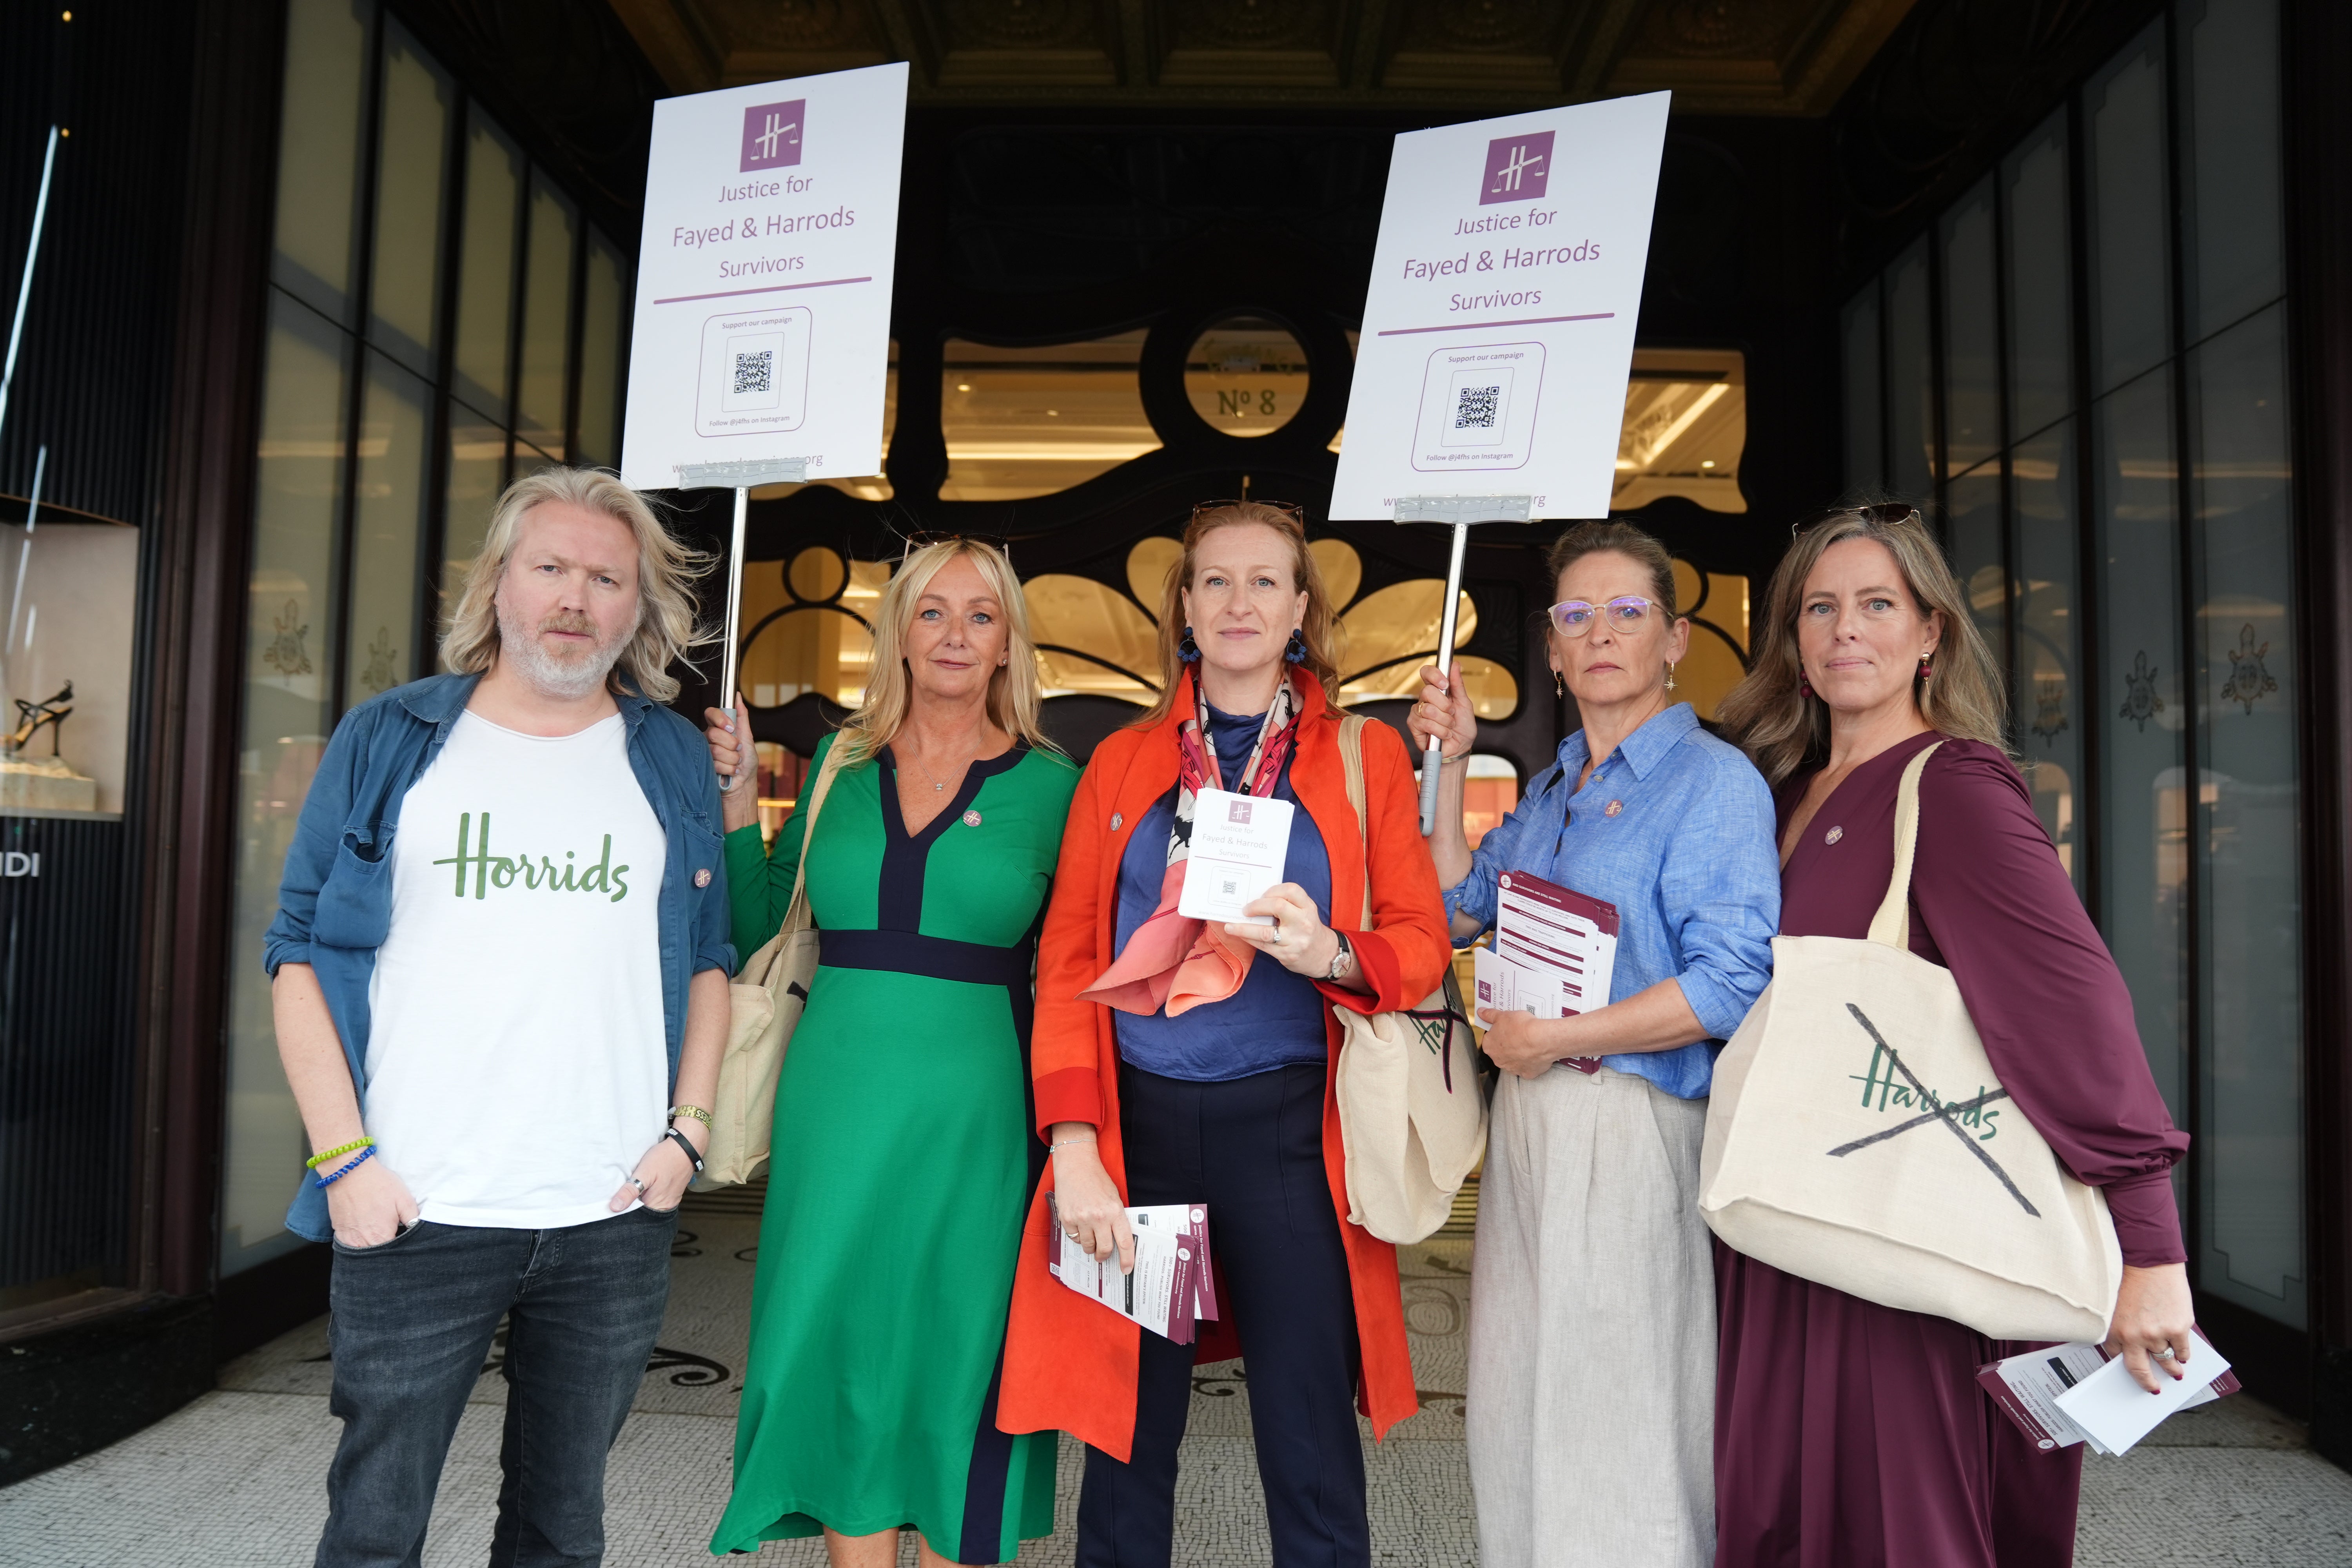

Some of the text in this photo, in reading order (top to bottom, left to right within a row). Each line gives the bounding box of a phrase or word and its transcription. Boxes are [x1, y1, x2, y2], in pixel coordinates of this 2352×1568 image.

[719, 176, 813, 202] Justice for
[673, 206, 854, 249] Fayed & Harrods
[1454, 208, 1557, 235] Justice for
[719, 256, 804, 278] Survivors
[1404, 240, 1600, 281] Fayed & Harrods
[1450, 290, 1541, 311] Survivors
[761, 317, 792, 325] campaign
[1260, 390, 1276, 415] 8
[1220, 824, 1242, 833] Justice
[1203, 833, 1225, 843] Fayed
[1236, 838, 1267, 849] Harrods
[433, 812, 629, 902] Horrids
[1219, 849, 1249, 858] Survivors
[1849, 1042, 2000, 1140] Harrods
[2010, 1381, 2025, 1398] WAITING.
[2018, 1380, 2029, 1392] FOUND
[2024, 1398, 2033, 1408] STILL
[2032, 1399, 2042, 1407] WHAT
[2040, 1407, 2052, 1419] PUBLISH
[2049, 1427, 2058, 1436] 500+
